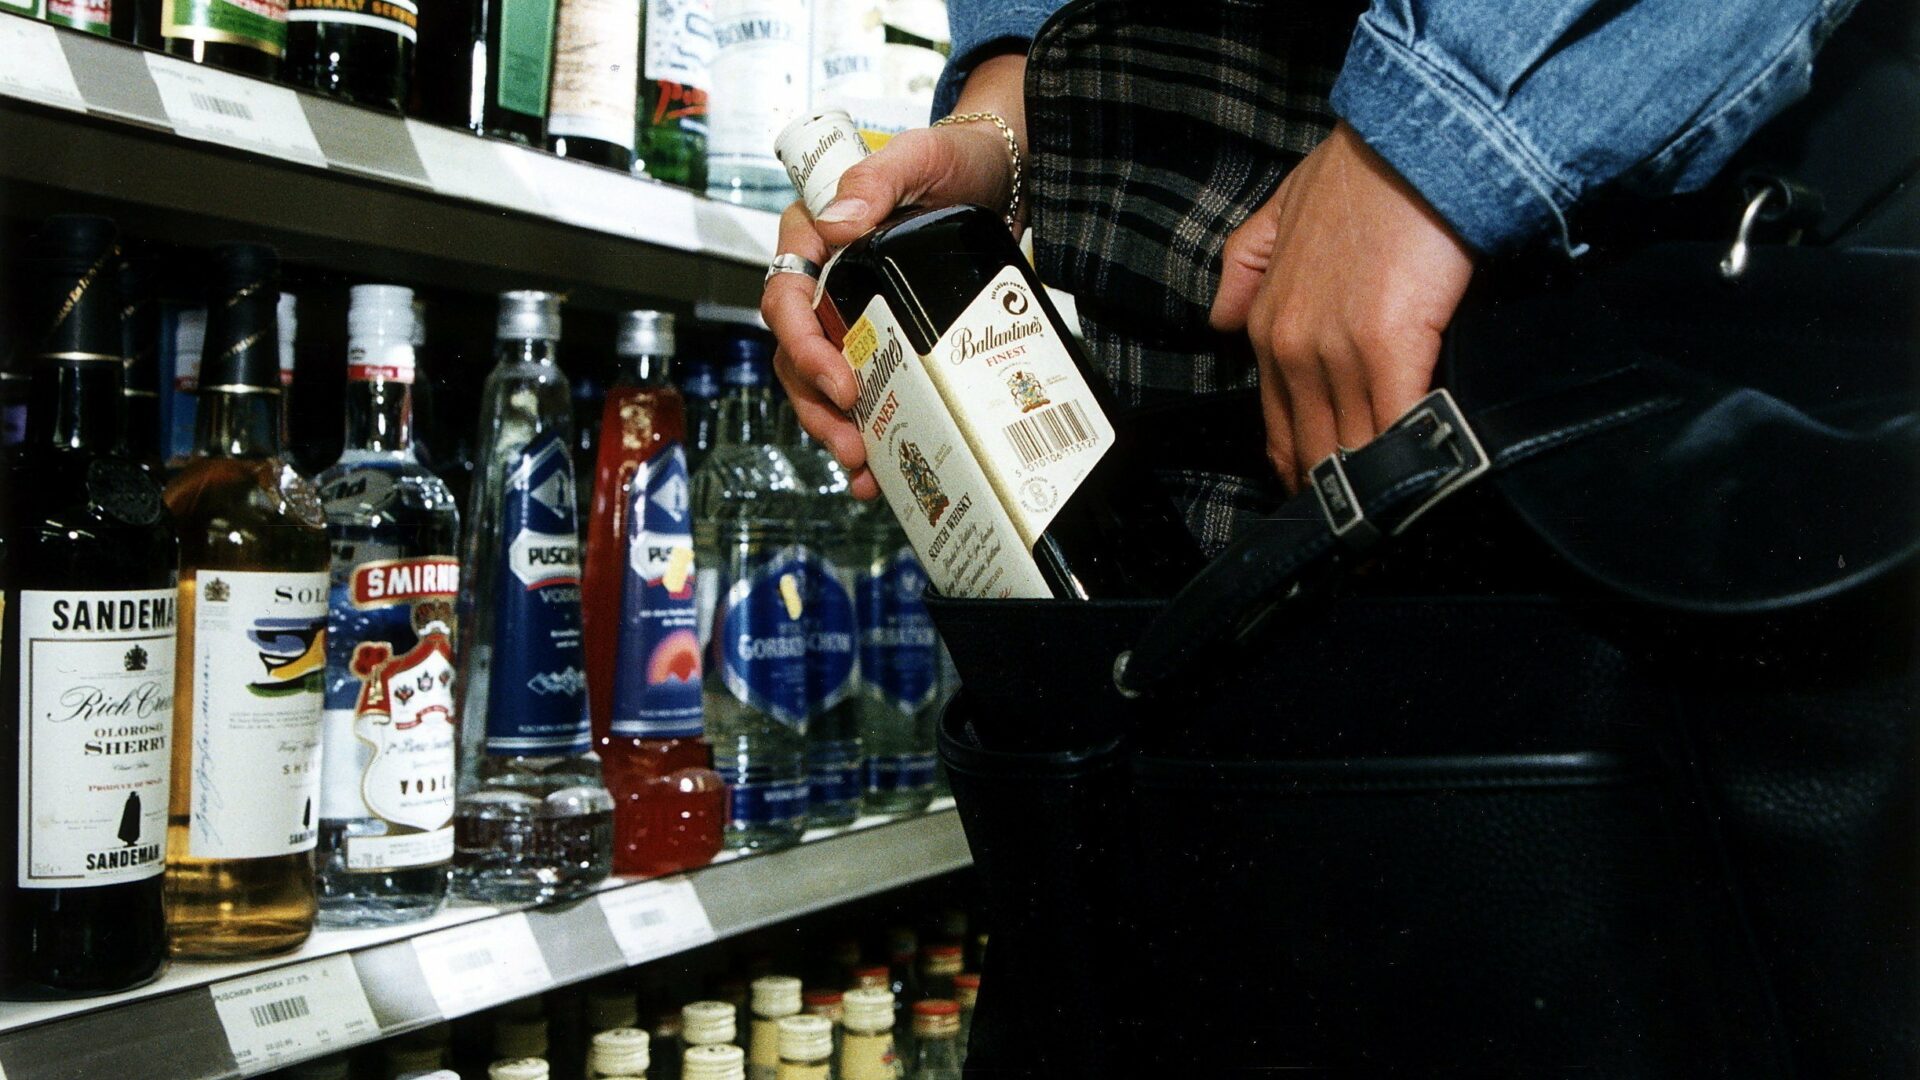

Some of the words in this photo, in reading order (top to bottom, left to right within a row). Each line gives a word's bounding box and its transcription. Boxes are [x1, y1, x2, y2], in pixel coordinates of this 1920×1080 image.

[790, 126, 844, 198] Ballantine's
[951, 316, 1043, 365] Ballantine's
[985, 345, 1028, 368] FINEST
[872, 390, 900, 441] FINEST
[1027, 453, 1063, 473] 010106
[928, 526, 951, 562] SCOTCH
[945, 491, 973, 531] WHISKY
[46, 685, 133, 723] Rich
[133, 681, 173, 719] Cre
[84, 736, 167, 757] SHERRY
[94, 722, 164, 738] OLOROSO
[86, 843, 160, 871] SANDEMAN
